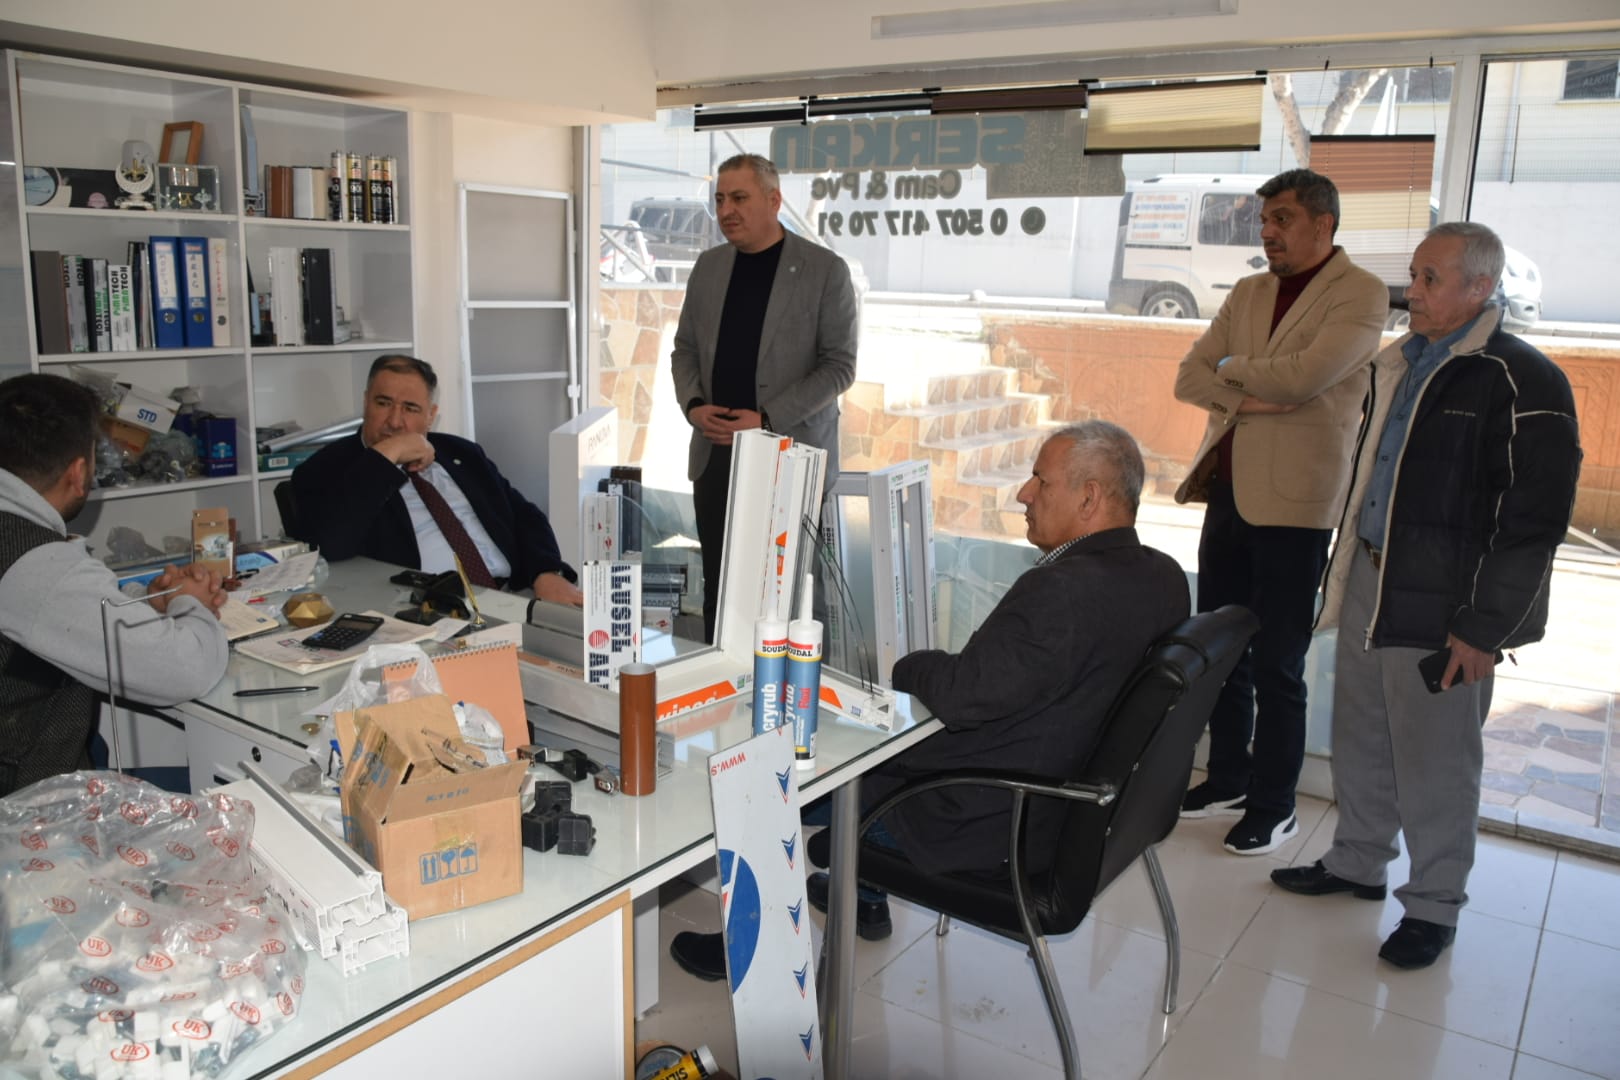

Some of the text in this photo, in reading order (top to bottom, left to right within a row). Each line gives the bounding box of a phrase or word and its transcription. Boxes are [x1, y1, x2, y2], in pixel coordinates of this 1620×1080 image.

[137, 408, 157, 424] STD
[761, 682, 778, 731] cryrub
[121, 1044, 141, 1056] UK
